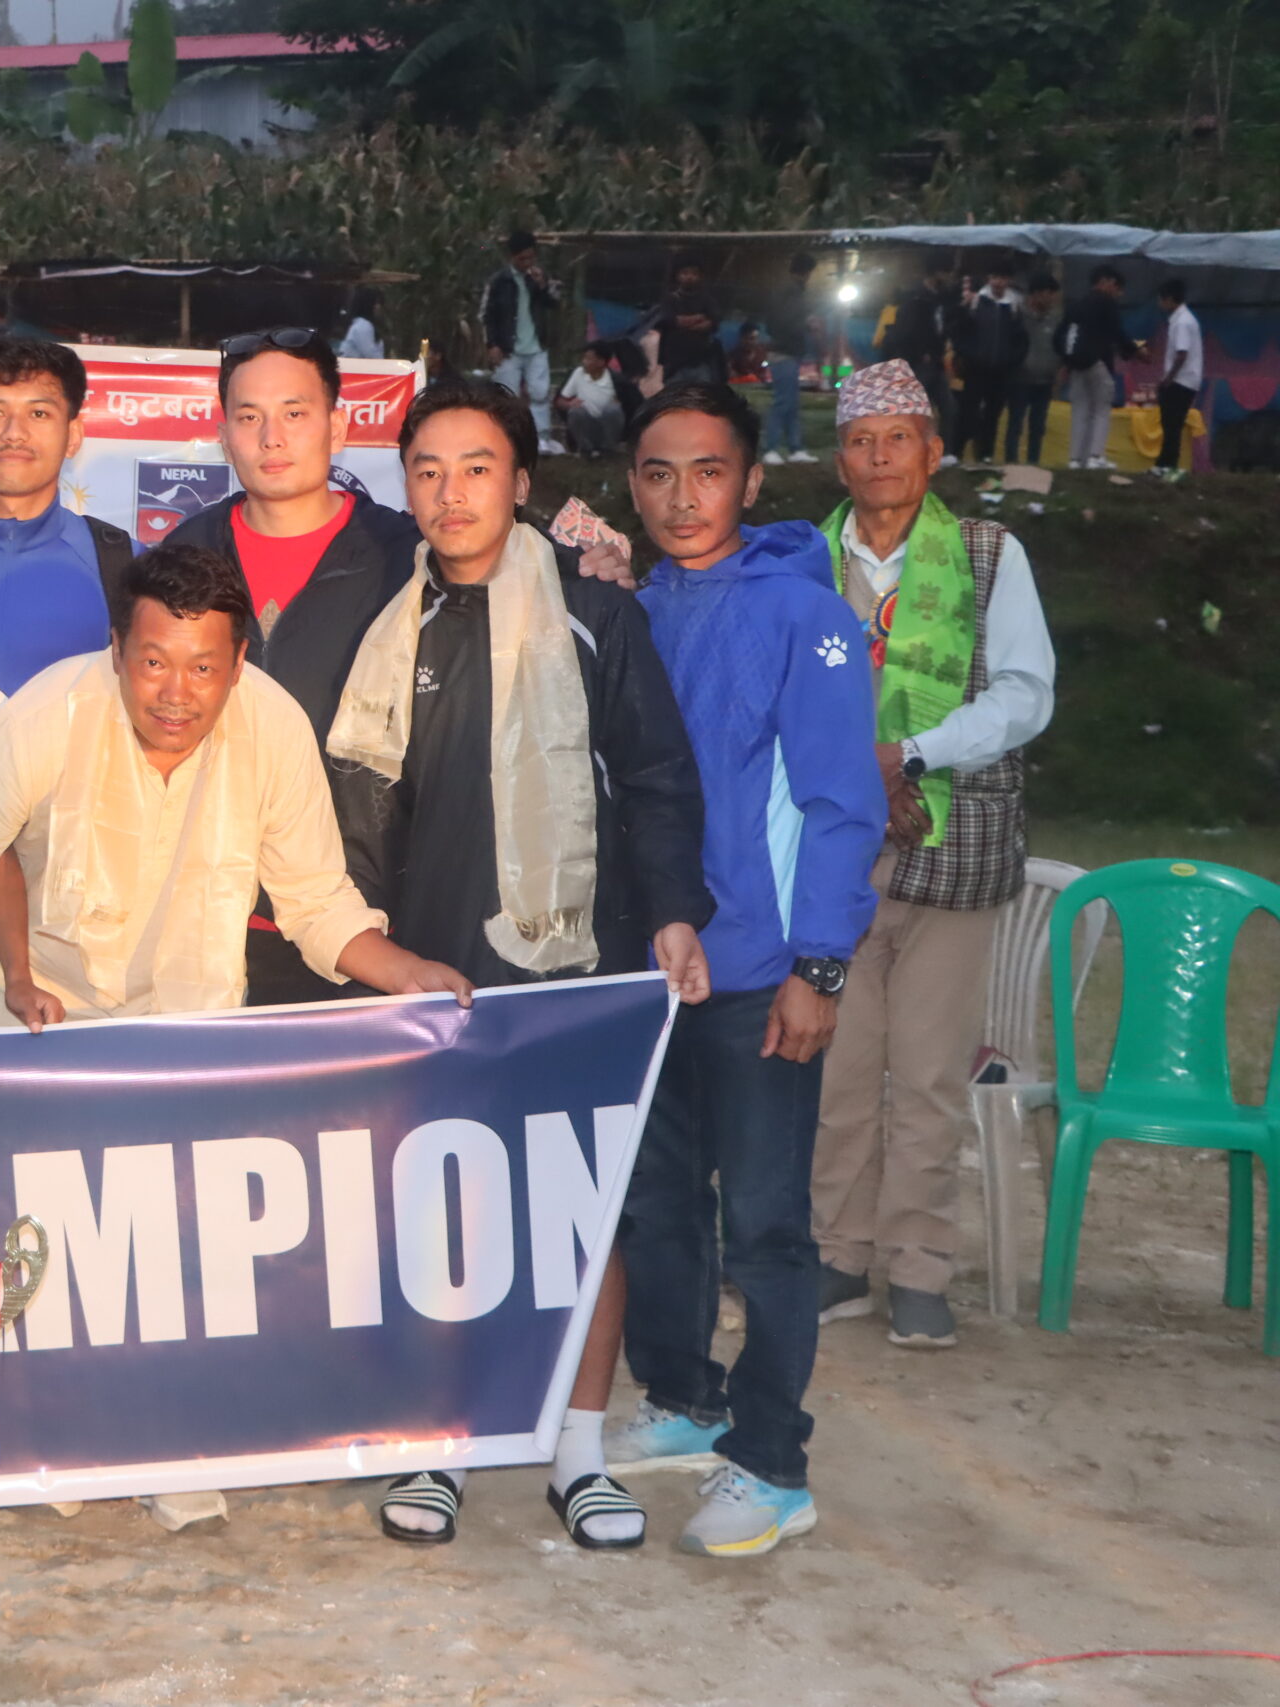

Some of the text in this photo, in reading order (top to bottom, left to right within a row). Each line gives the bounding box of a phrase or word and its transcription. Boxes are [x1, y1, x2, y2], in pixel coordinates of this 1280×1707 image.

[106, 391, 215, 426] फुटबल
[160, 467, 207, 482] NEPAL
[416, 683, 441, 693] ELME
